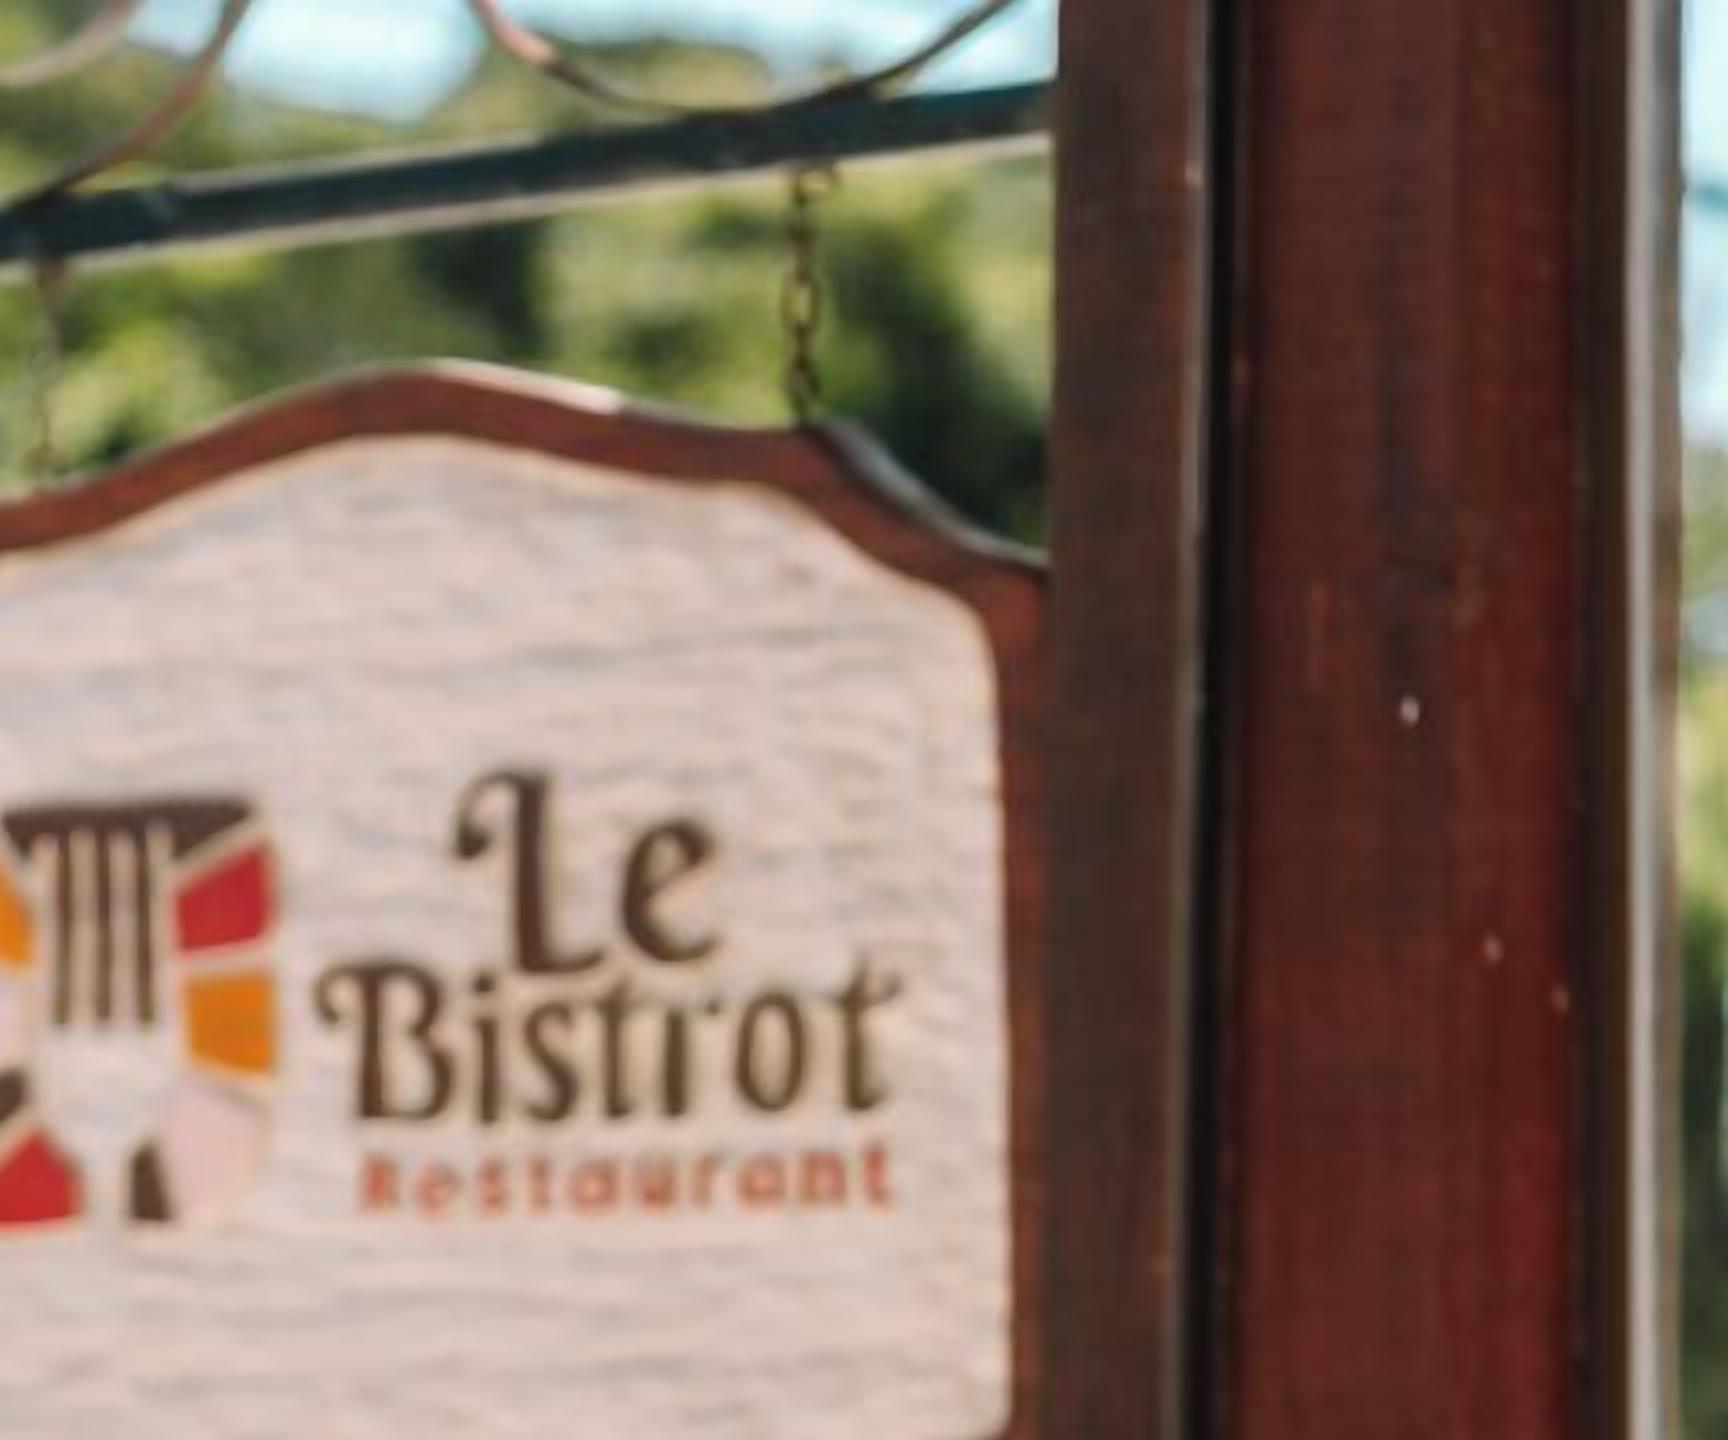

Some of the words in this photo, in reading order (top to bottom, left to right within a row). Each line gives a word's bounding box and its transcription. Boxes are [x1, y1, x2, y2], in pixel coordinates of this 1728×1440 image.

[450, 769, 720, 976] Le
[313, 952, 904, 1124] Bistrot
[359, 1140, 894, 1215] Restaurant
